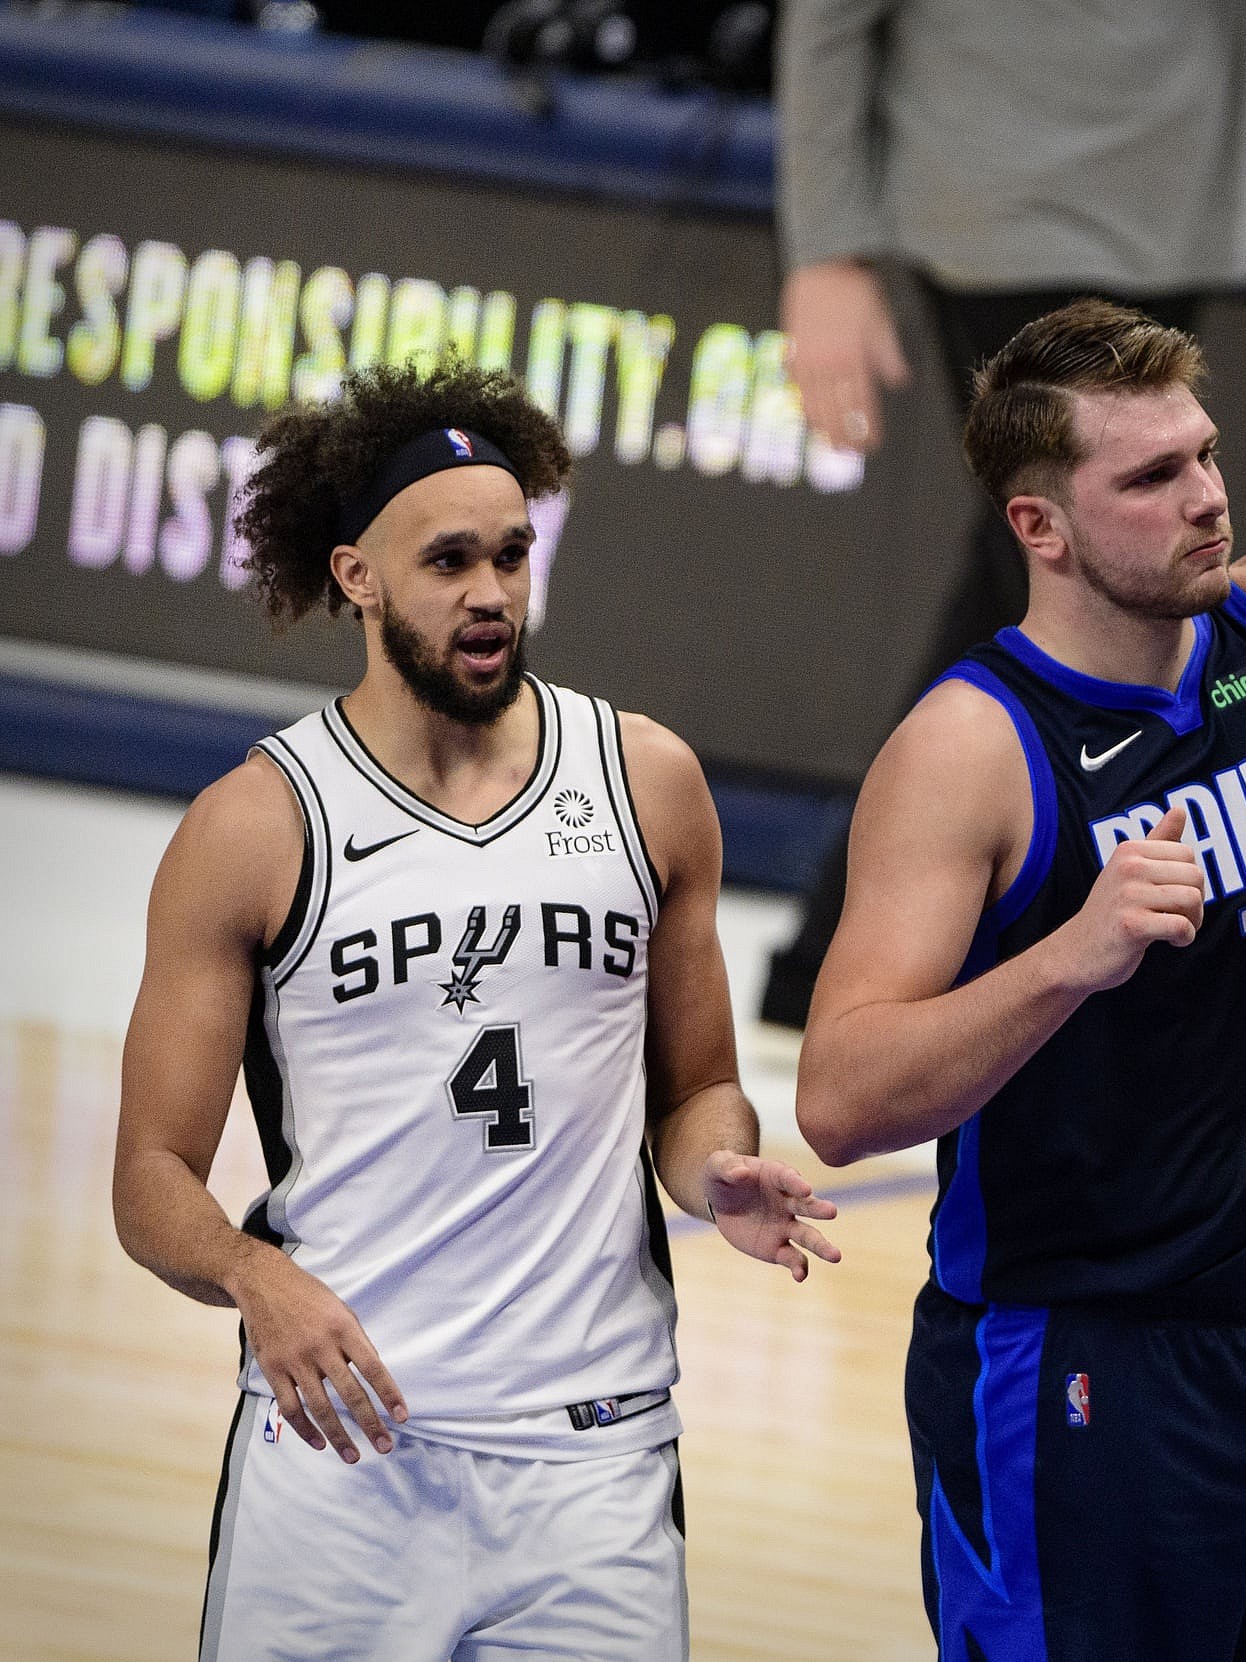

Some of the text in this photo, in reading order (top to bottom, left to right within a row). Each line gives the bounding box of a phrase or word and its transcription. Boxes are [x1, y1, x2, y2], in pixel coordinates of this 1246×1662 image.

[545, 829, 616, 857] Frost
[330, 902, 639, 1019] SPURS
[443, 1022, 537, 1154] 4
